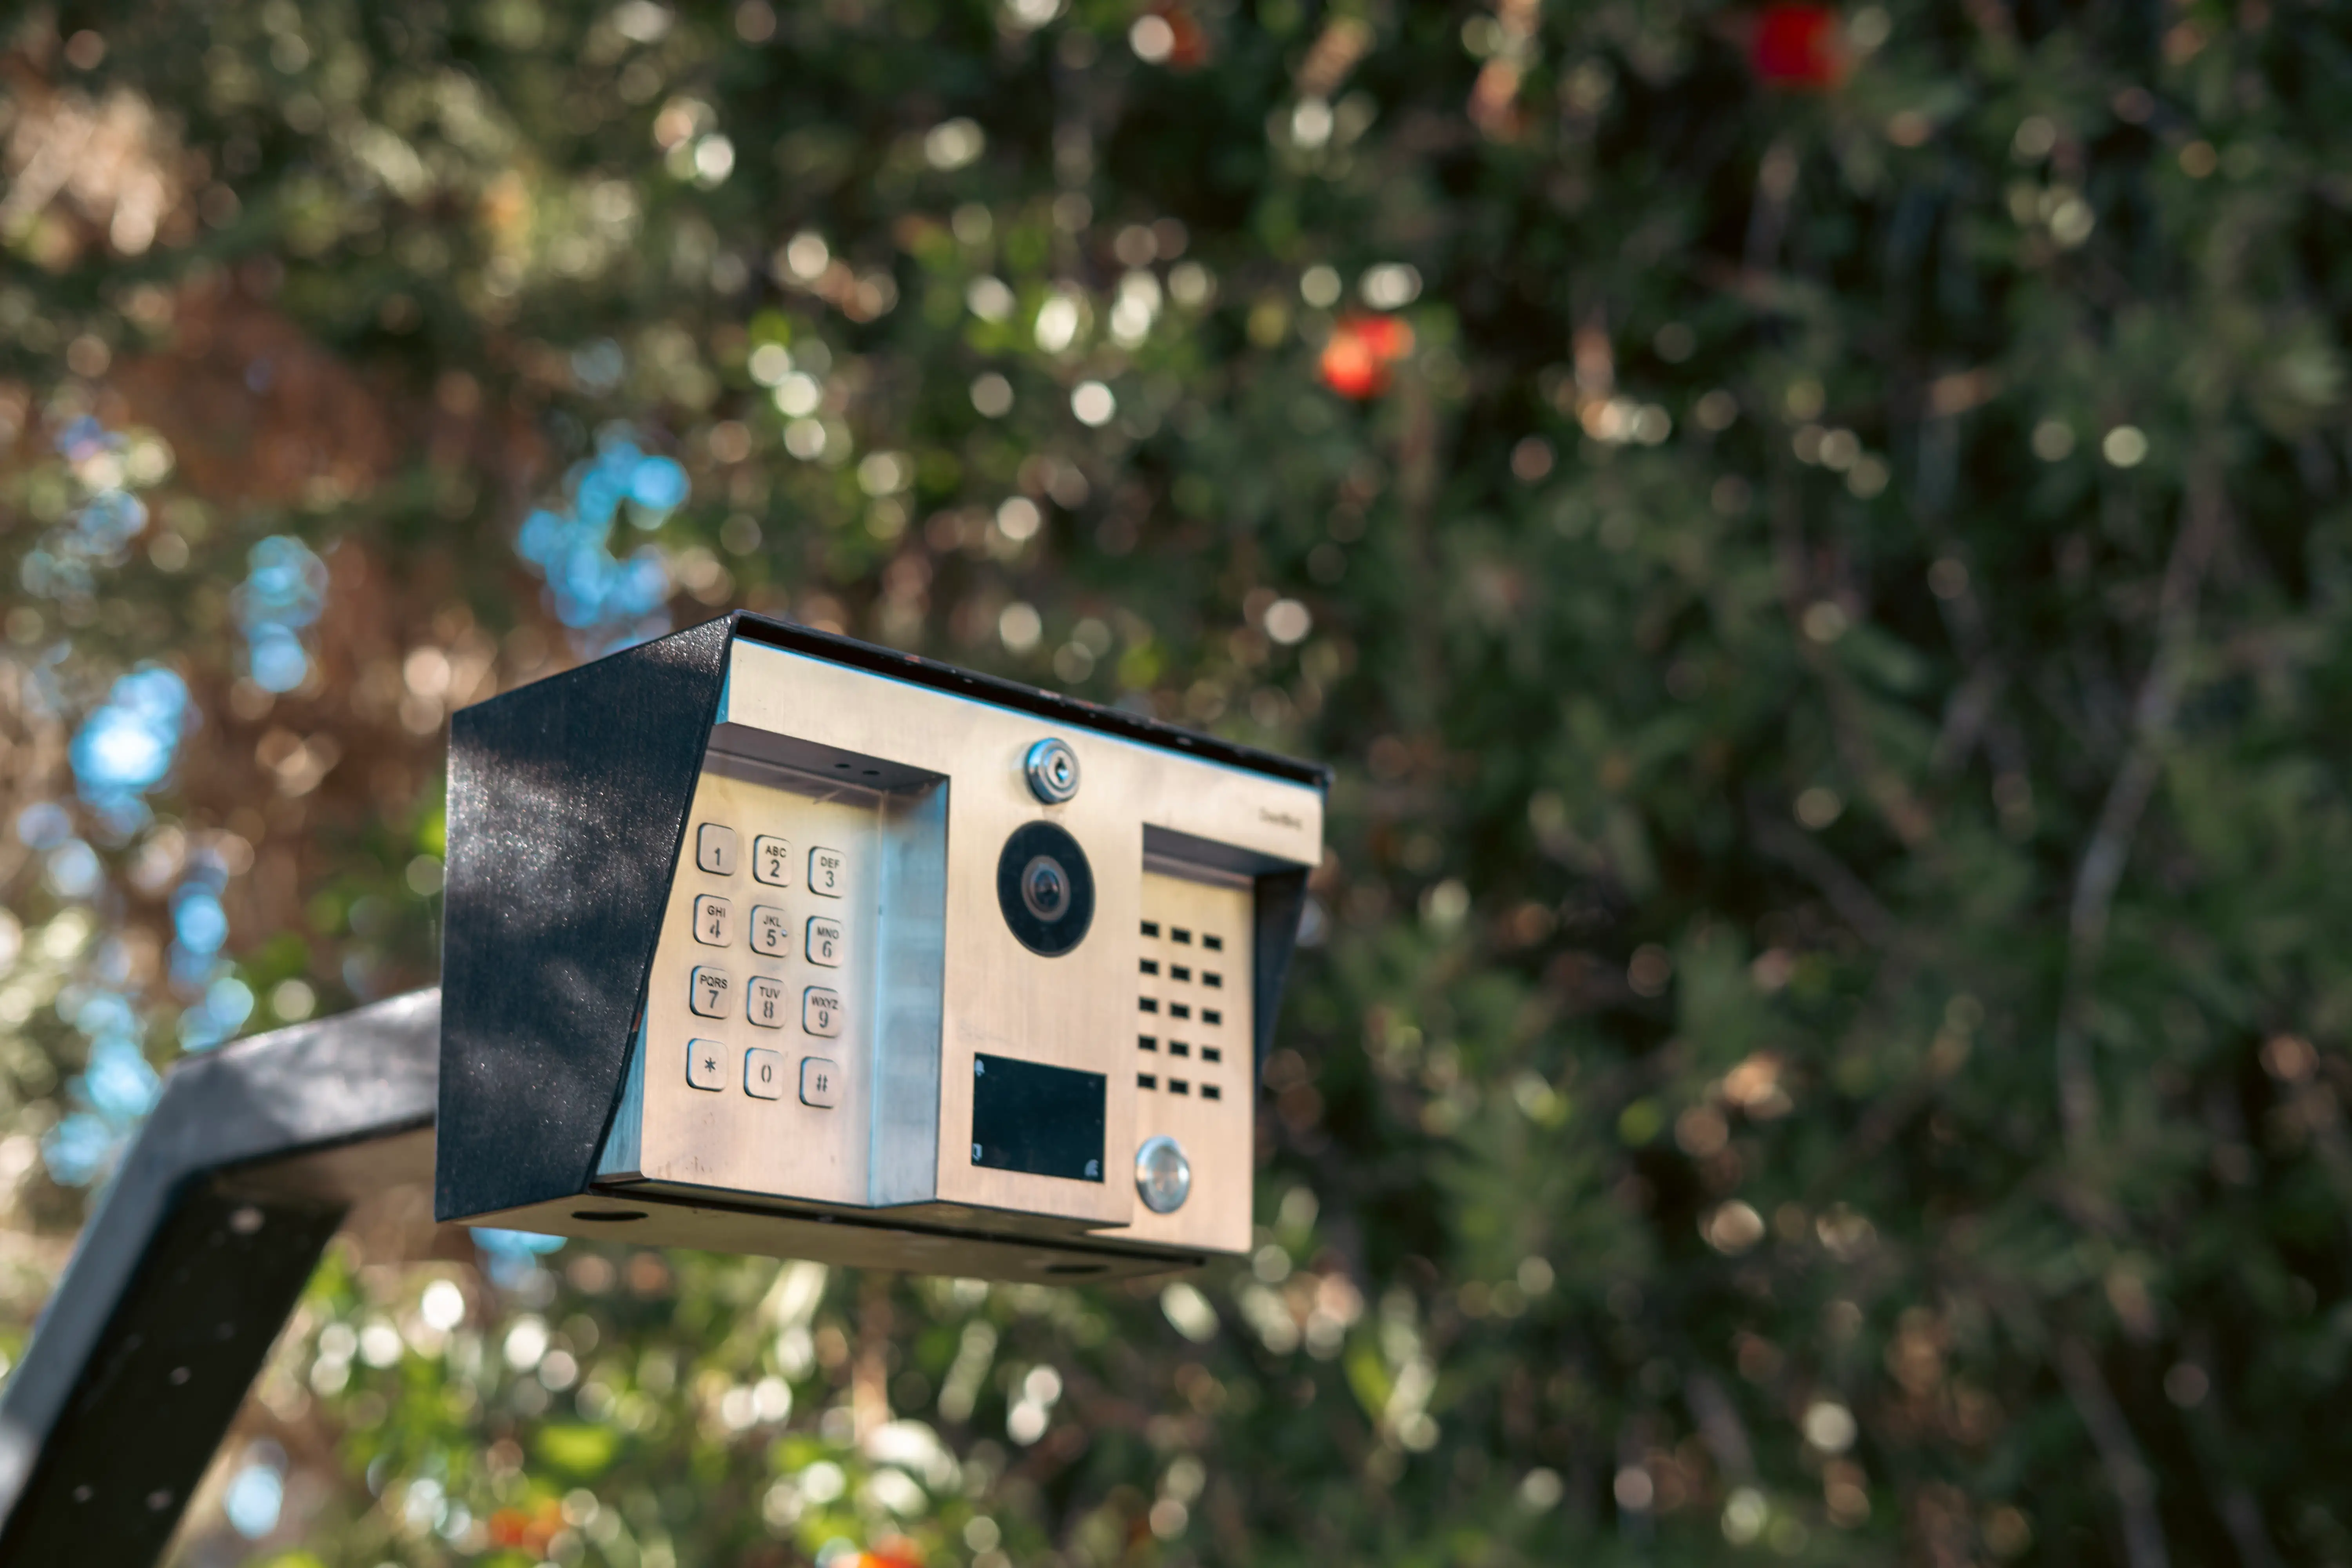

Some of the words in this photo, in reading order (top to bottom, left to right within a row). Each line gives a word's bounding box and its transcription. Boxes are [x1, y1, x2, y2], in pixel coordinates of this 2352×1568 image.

[714, 847, 721, 866] 1
[765, 845, 787, 858] ABC
[770, 859, 780, 878] 2
[820, 856, 840, 869] DEF
[825, 870, 835, 888] 3
[707, 905, 726, 918] GHI
[709, 919, 721, 939] 4
[763, 915, 782, 927] JKL
[766, 929, 777, 947] 5
[817, 926, 839, 940] MNO
[822, 940, 832, 958] 6
[700, 975, 728, 989] PQRS
[708, 989, 719, 1009] 7
[759, 986, 780, 1000] TUV
[763, 1000, 774, 1019] 8
[811, 995, 838, 1010] WXYZ
[818, 1010, 829, 1028] 9
[761, 1064, 772, 1083] 0
[816, 1073, 828, 1093] #
